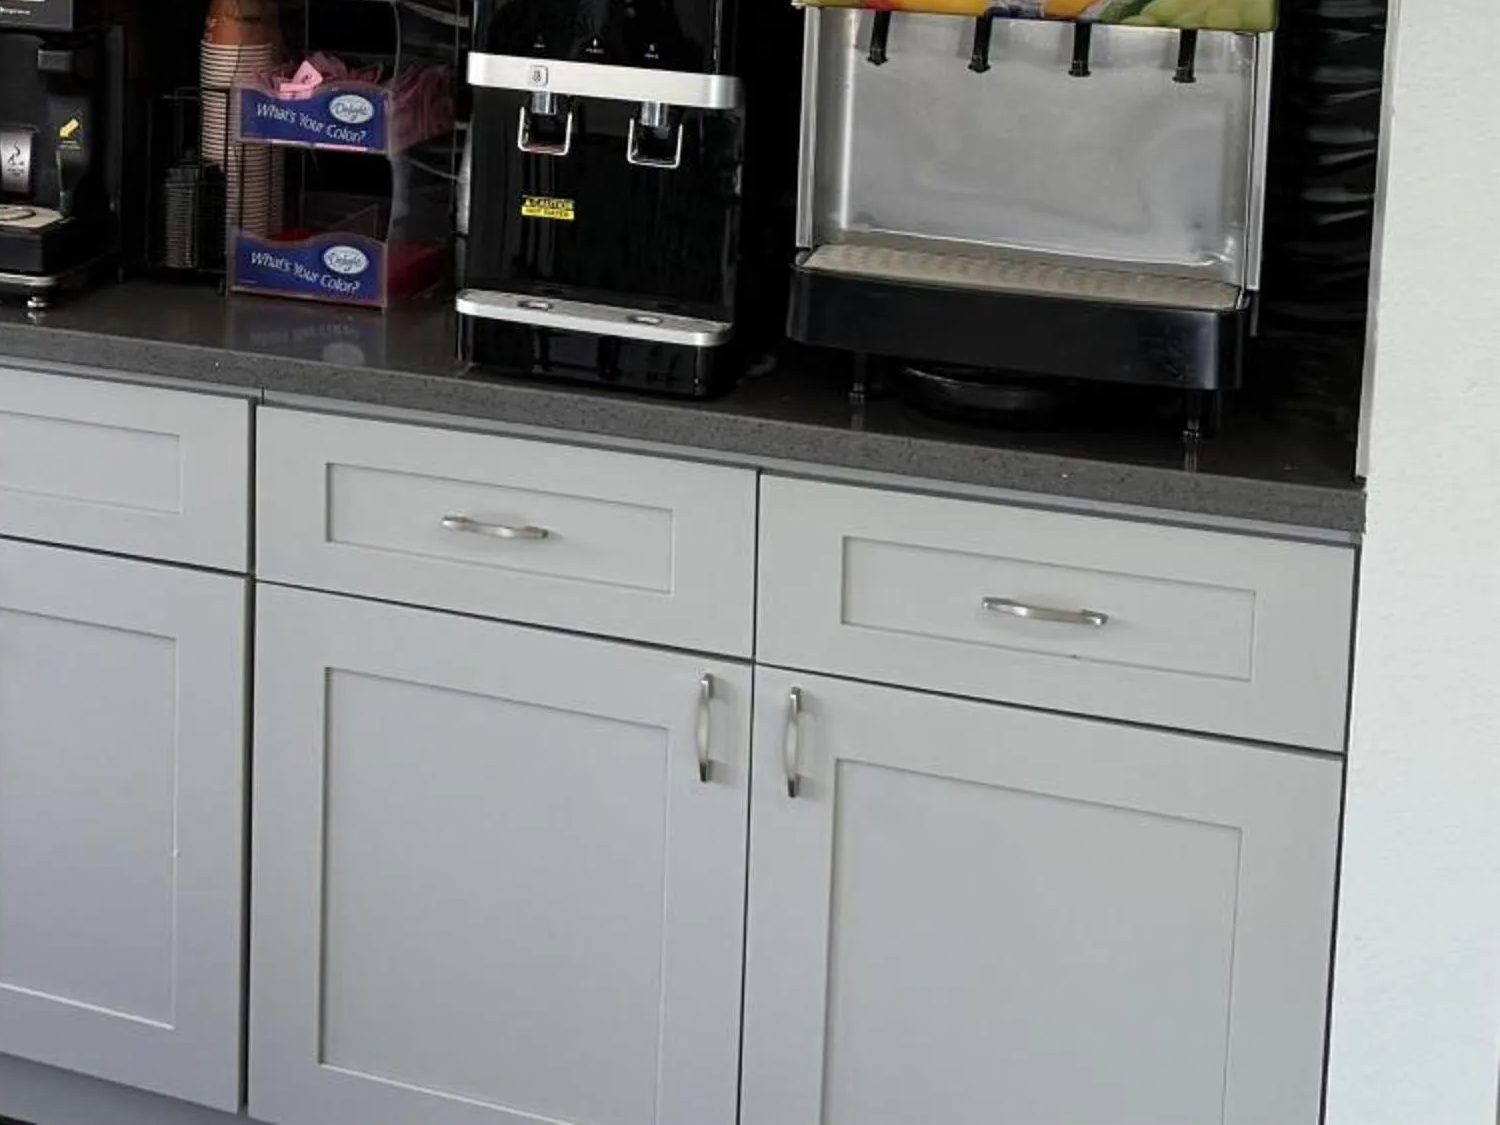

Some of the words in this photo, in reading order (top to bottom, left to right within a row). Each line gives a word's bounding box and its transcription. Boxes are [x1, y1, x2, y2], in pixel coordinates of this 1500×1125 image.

[256, 102, 297, 124] What's
[299, 112, 324, 133] Your
[326, 124, 367, 143] Color?
[250, 251, 292, 273] What's
[294, 261, 320, 283] Your
[320, 274, 361, 294] Color?
